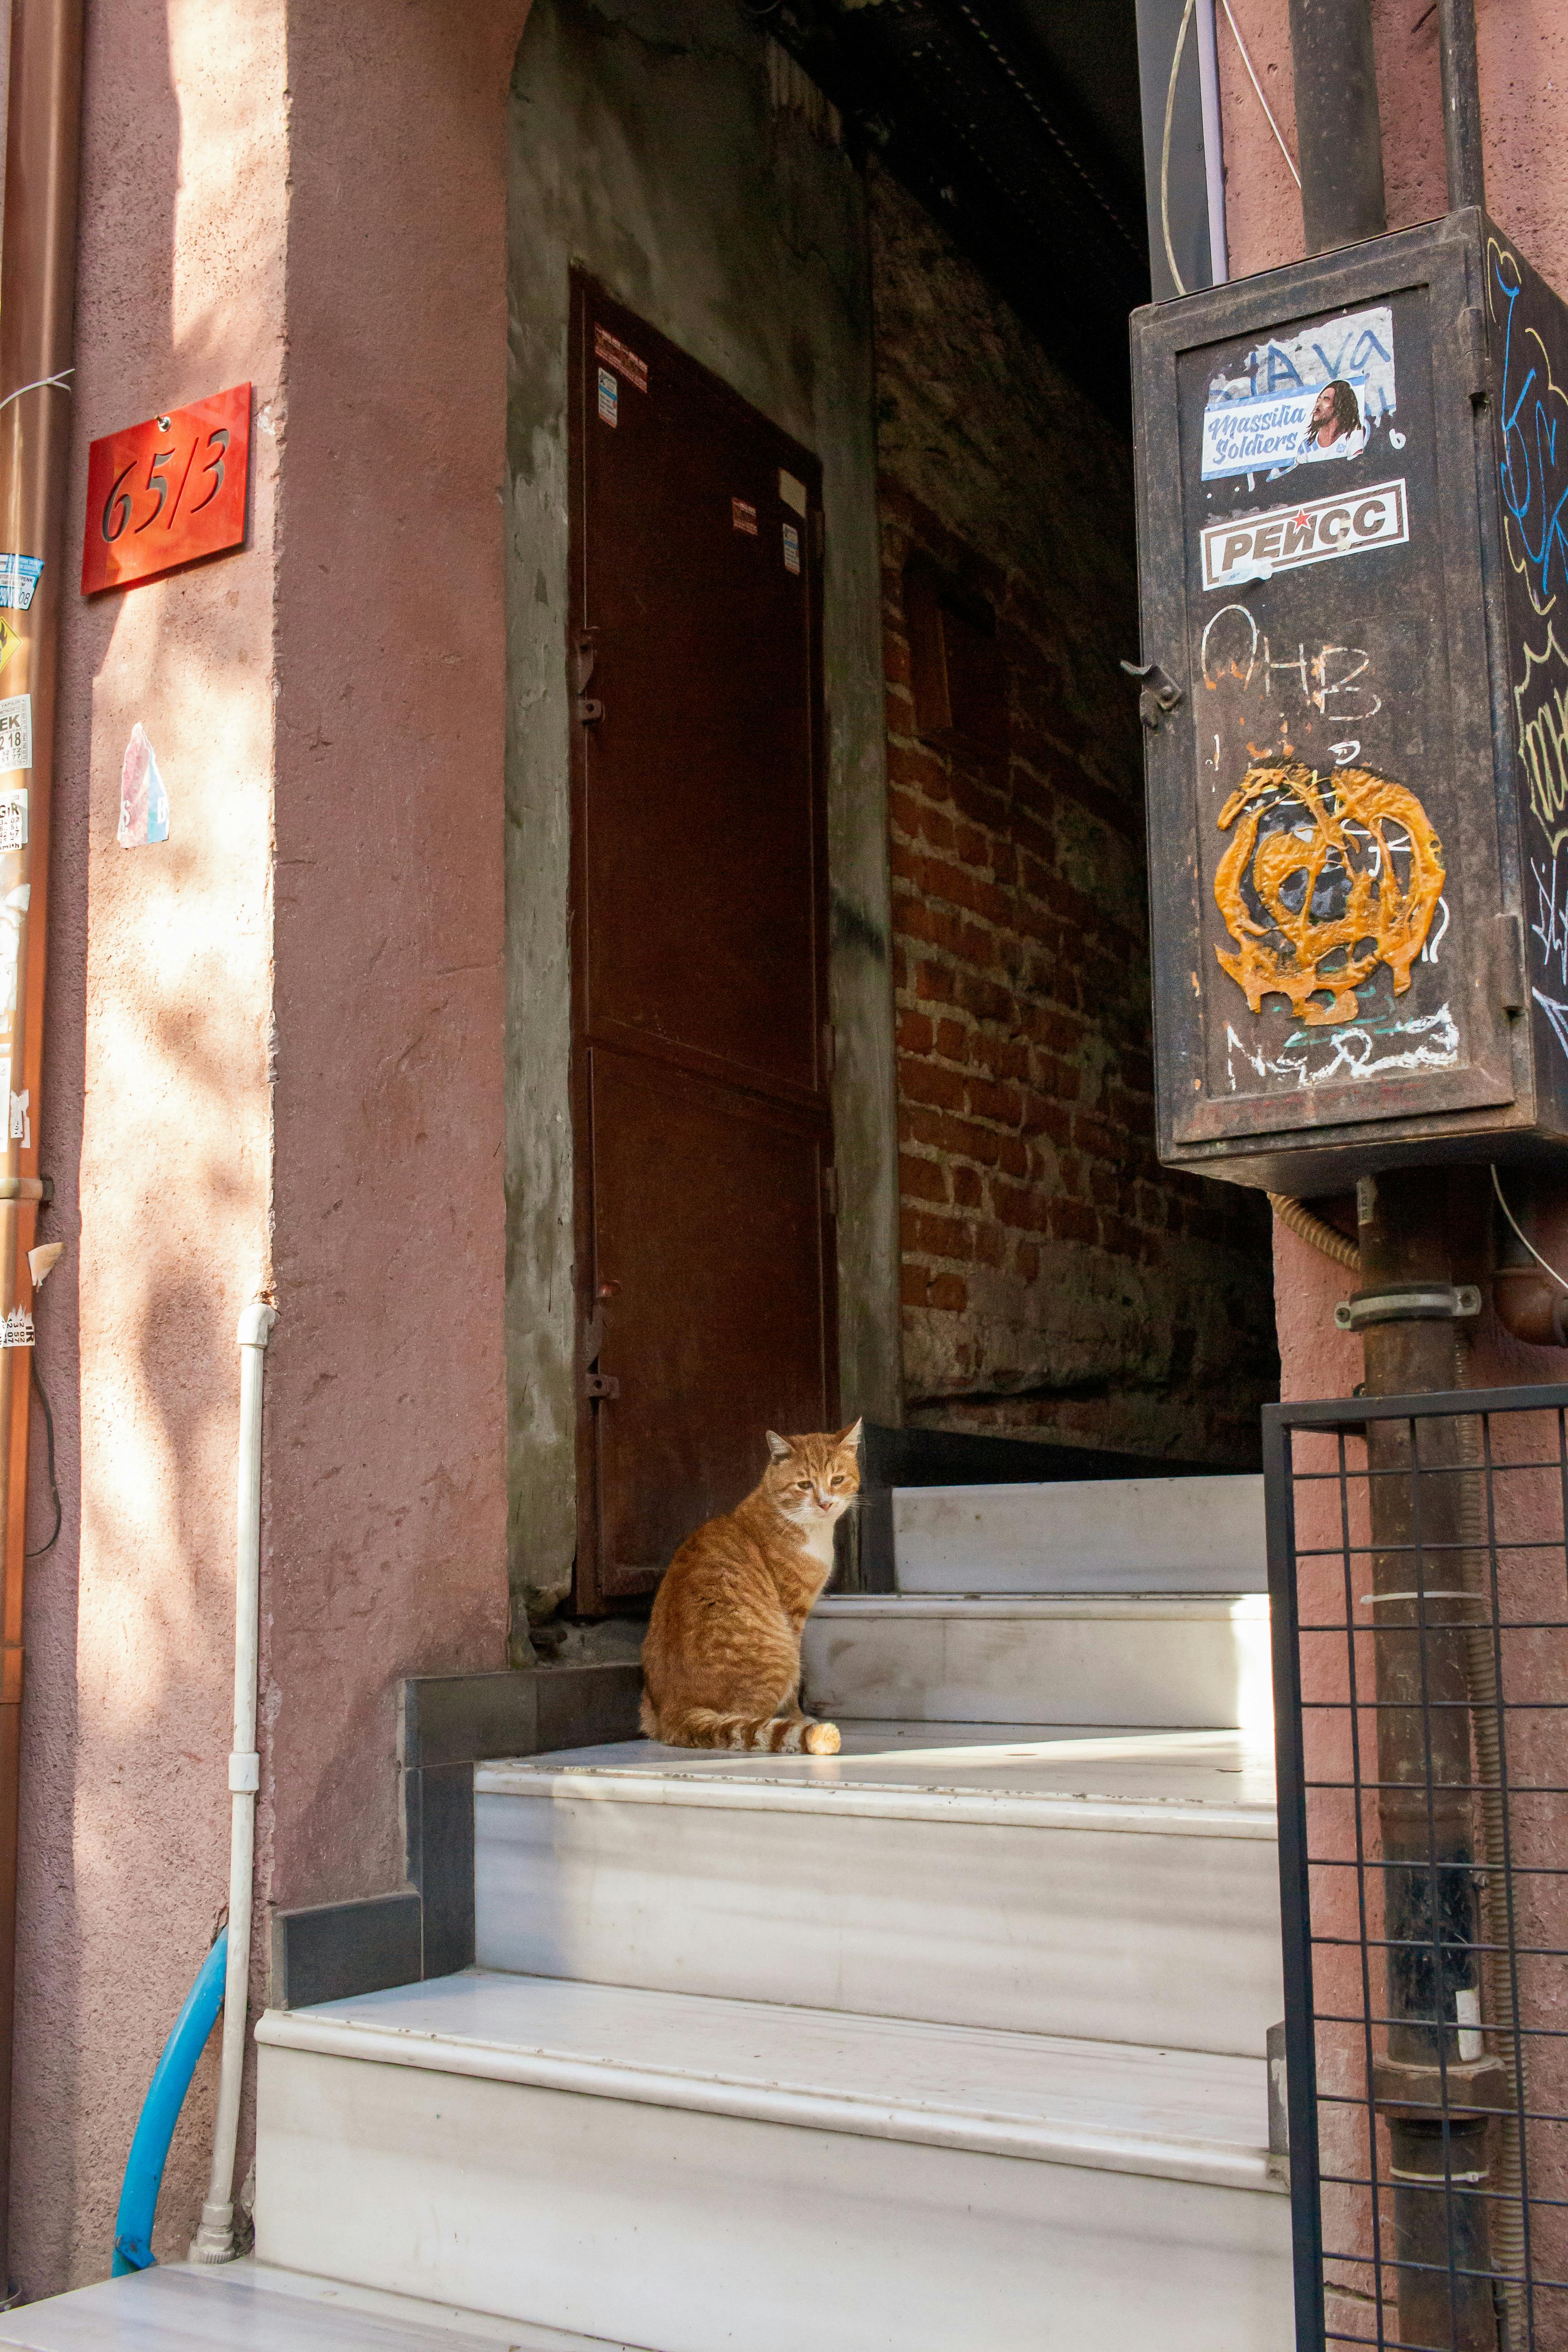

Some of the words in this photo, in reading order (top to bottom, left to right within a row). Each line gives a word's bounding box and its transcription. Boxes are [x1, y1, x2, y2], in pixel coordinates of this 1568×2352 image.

[1208, 404, 1306, 440] Massilia
[1212, 432, 1298, 465] Soldiers
[102, 428, 230, 544] 65/3
[9, 732, 21, 748] 18
